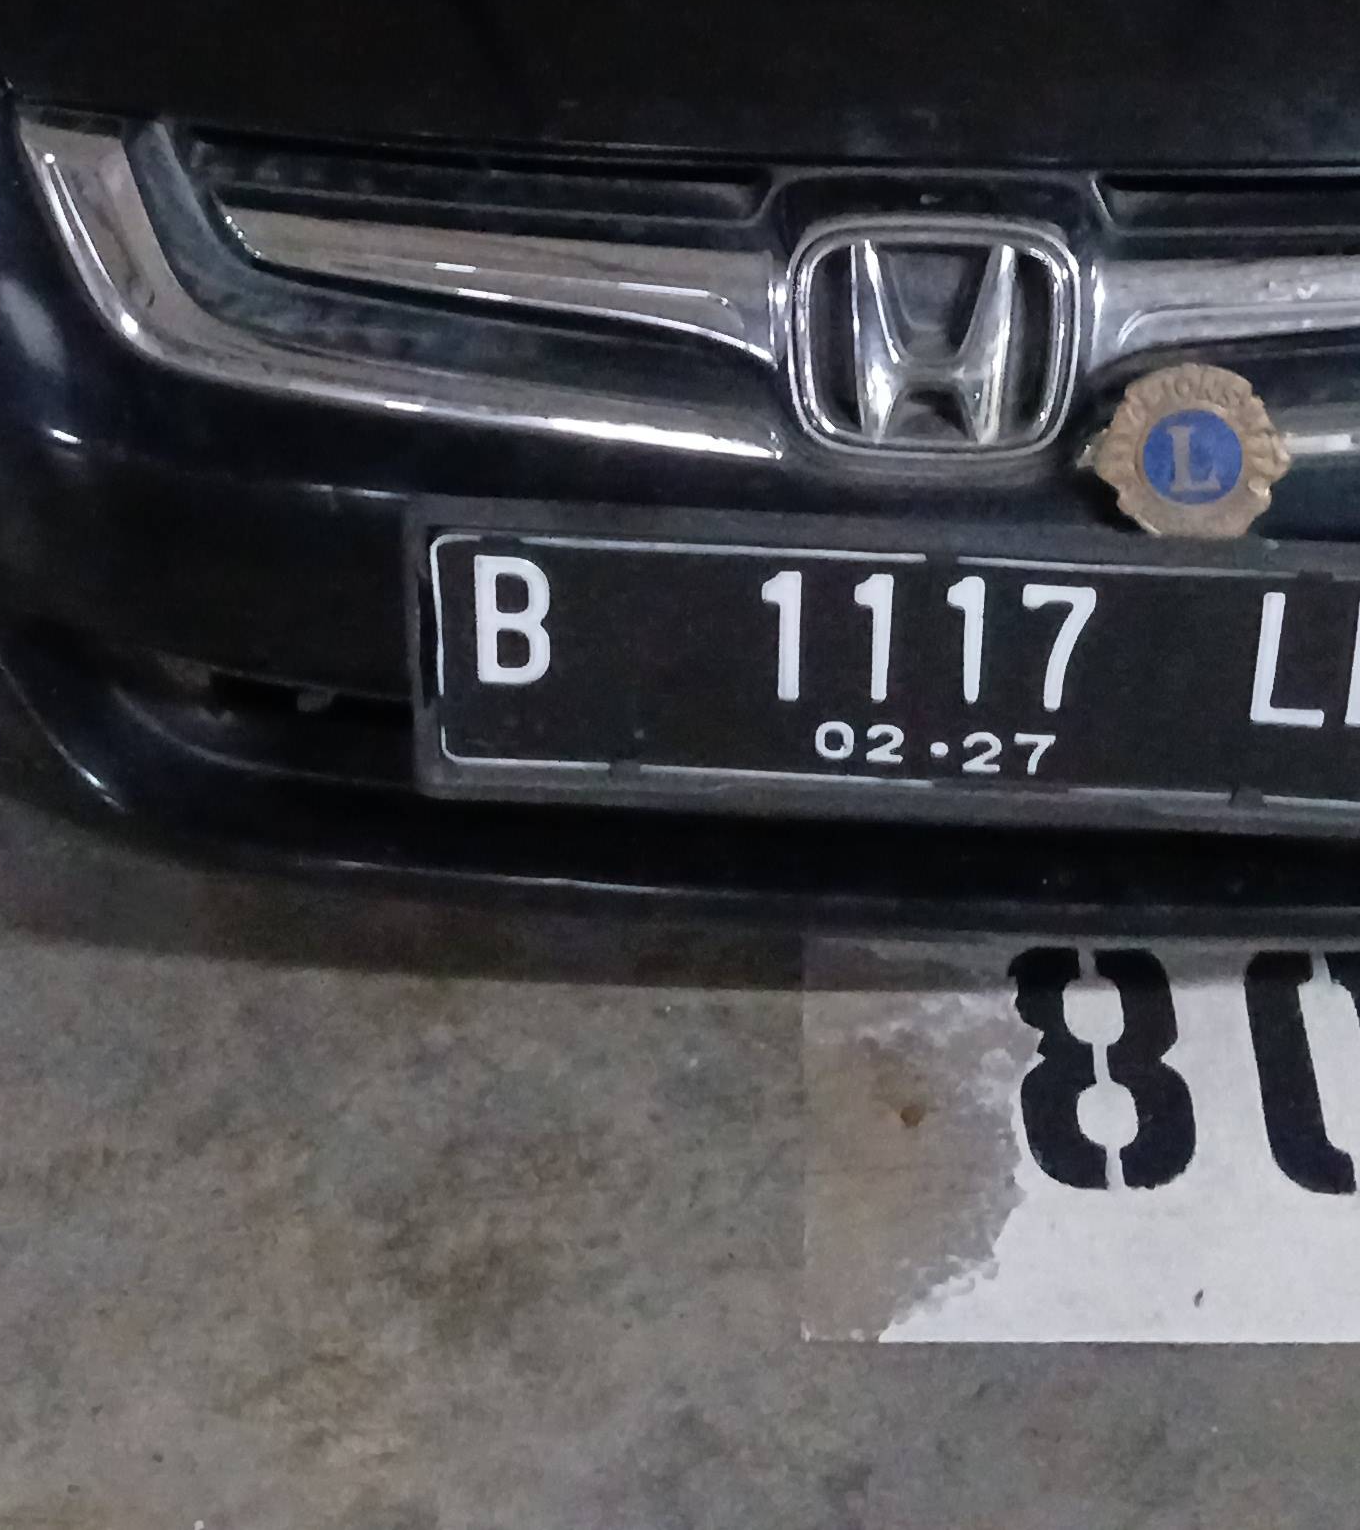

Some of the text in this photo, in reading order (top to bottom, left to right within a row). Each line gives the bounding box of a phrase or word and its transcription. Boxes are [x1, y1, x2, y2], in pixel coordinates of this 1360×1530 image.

[1166, 425, 1222, 493] L
[473, 554, 552, 686] B
[761, 570, 1097, 712] 1117
